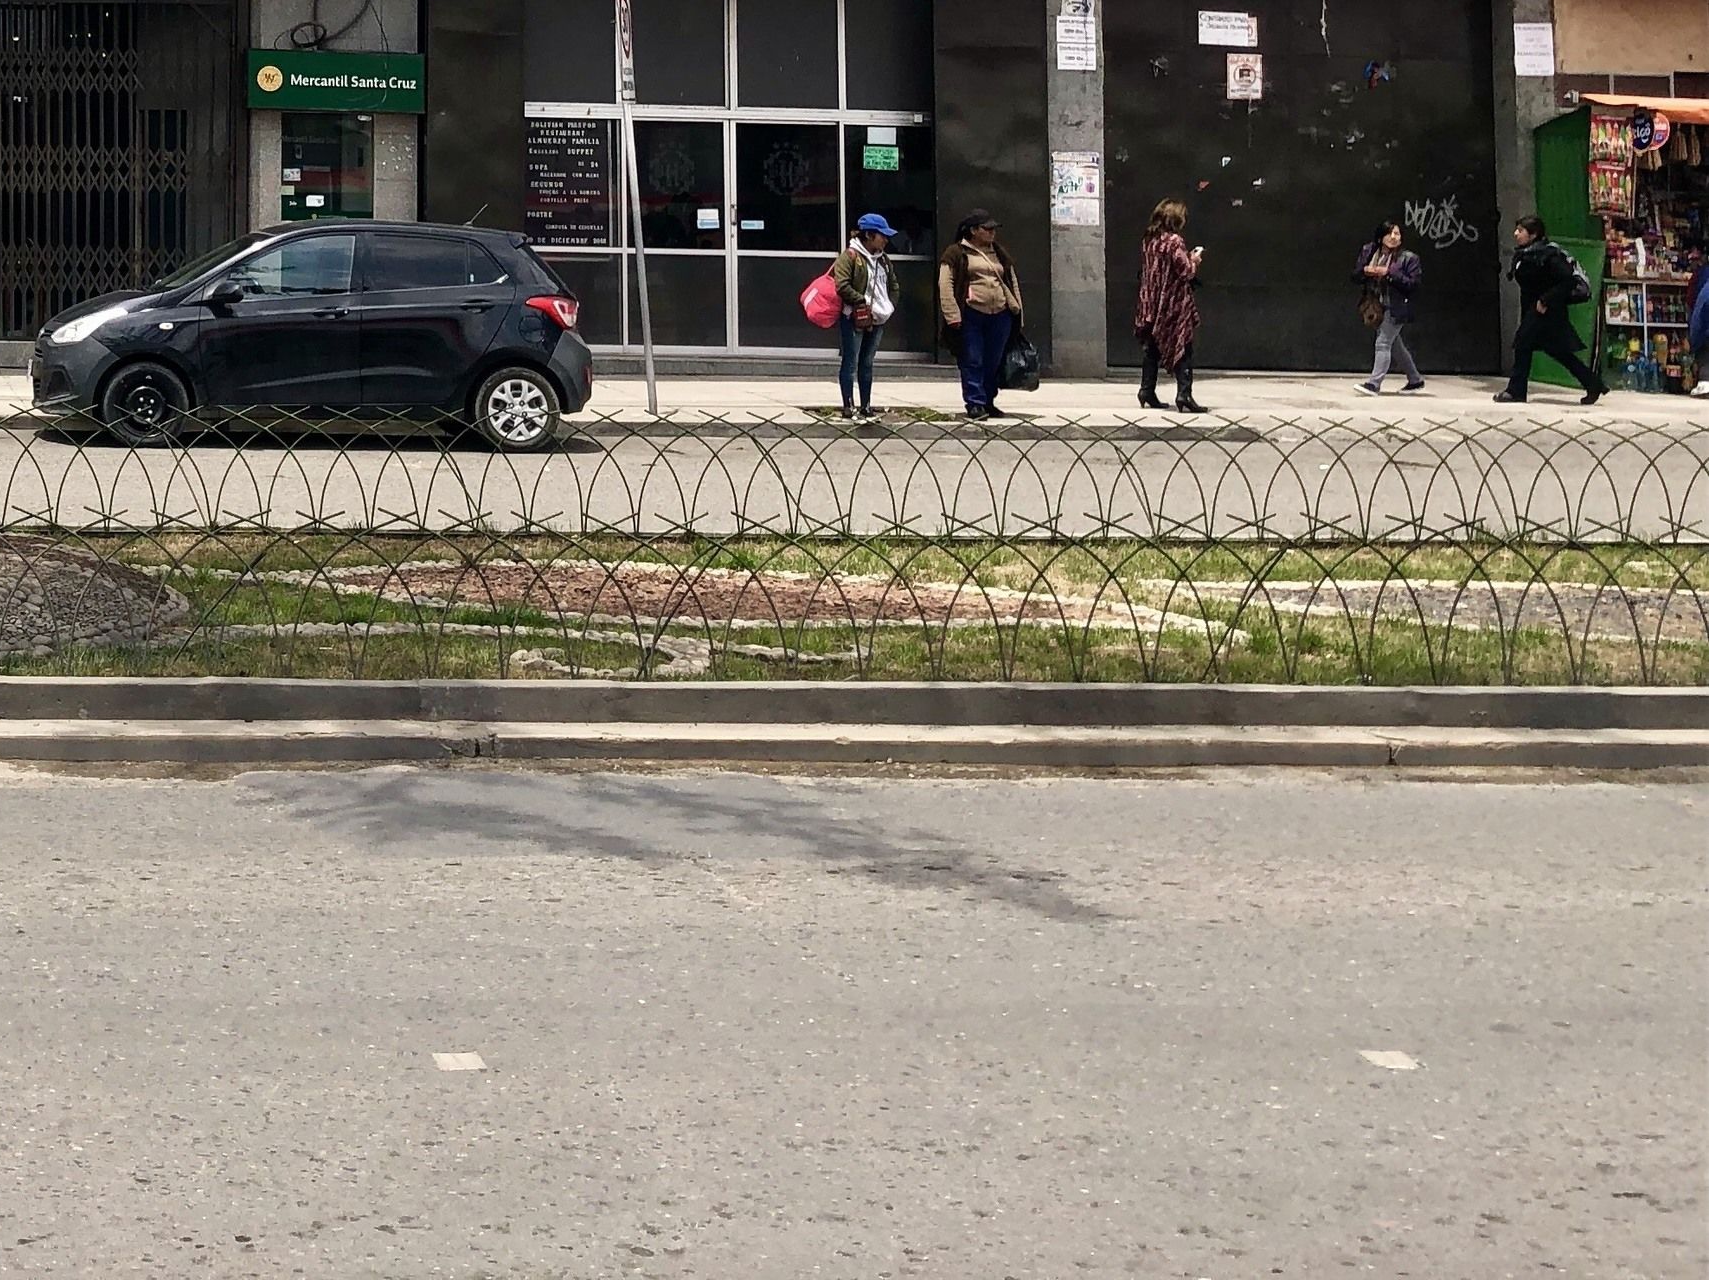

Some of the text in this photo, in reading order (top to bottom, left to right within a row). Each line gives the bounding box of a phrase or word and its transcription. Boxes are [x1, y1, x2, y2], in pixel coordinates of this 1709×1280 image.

[290, 74, 417, 90] Mercantil Santa Cruz
